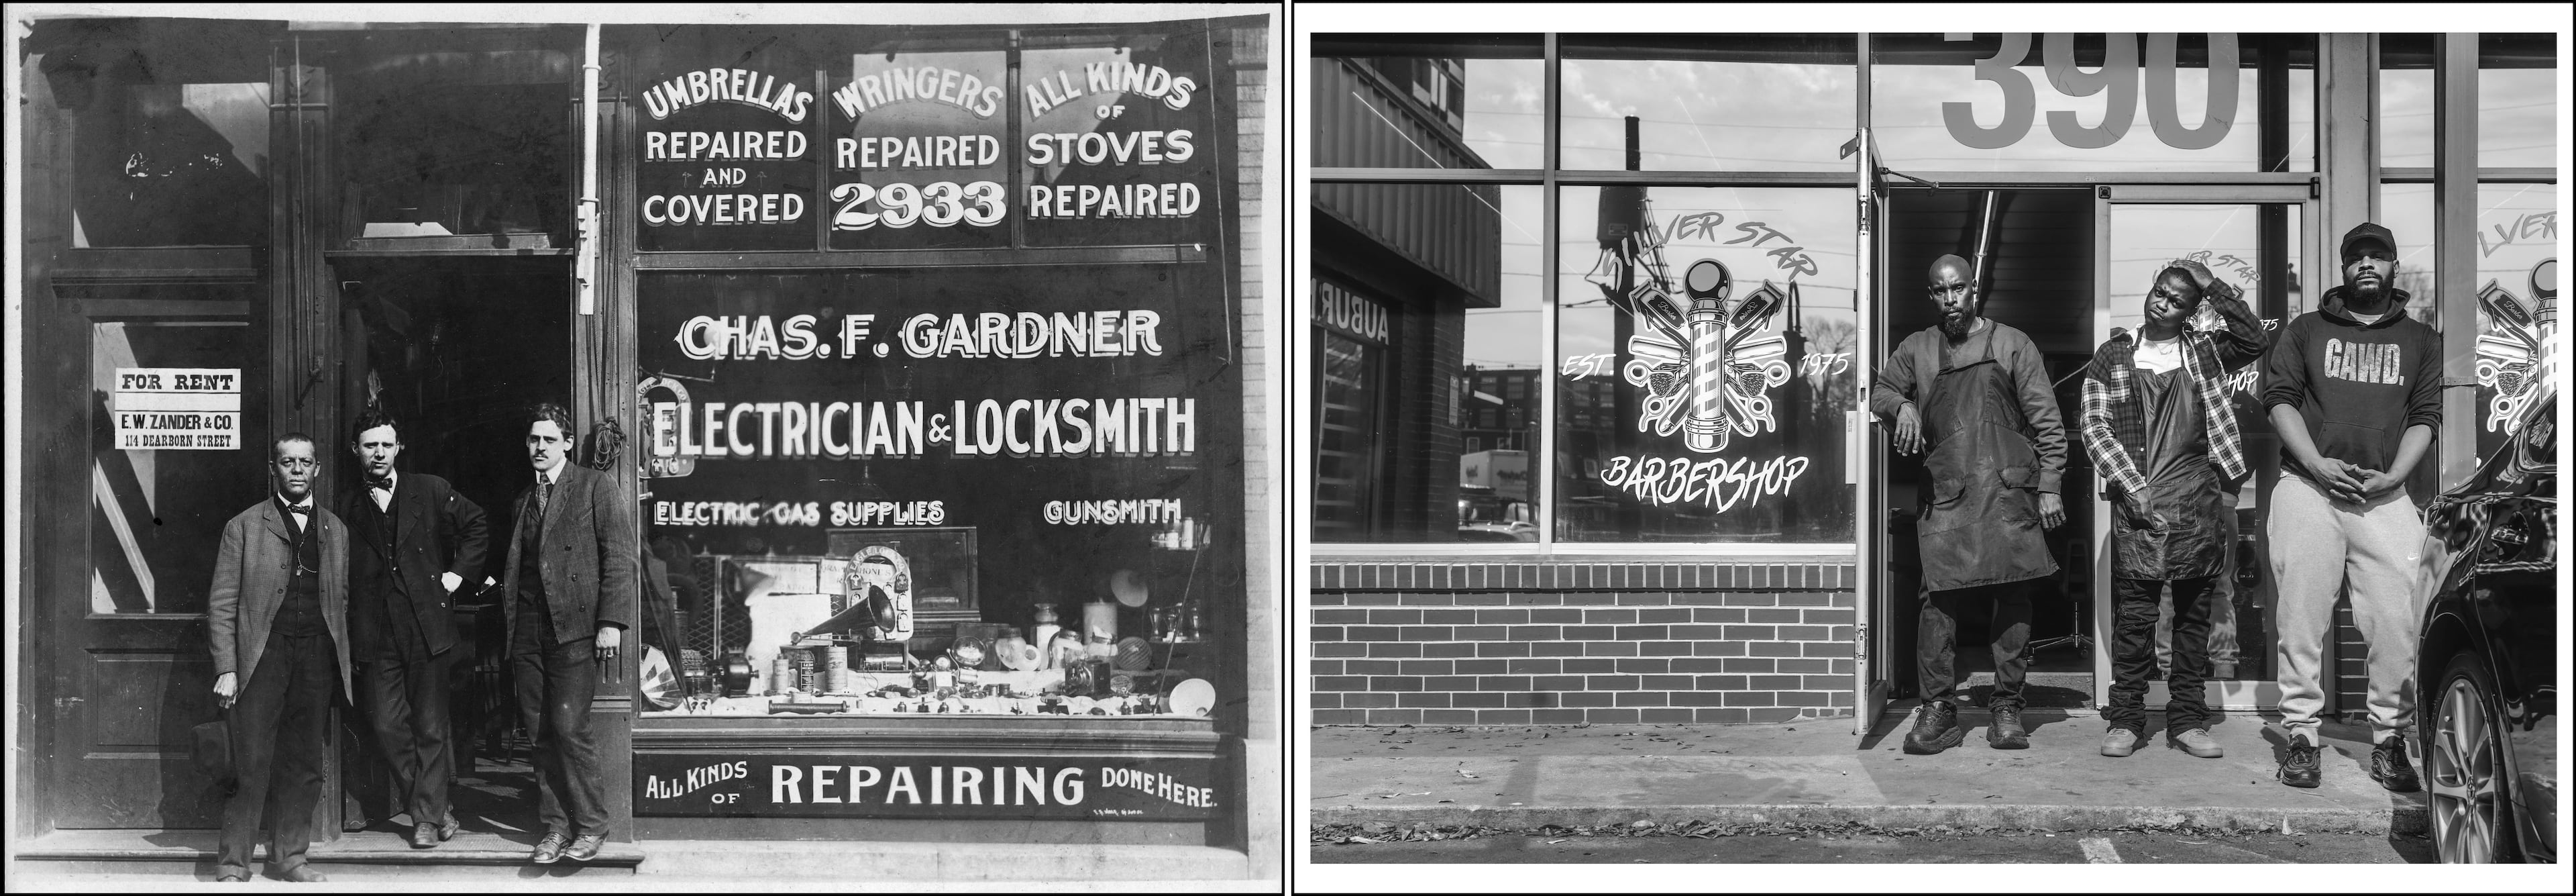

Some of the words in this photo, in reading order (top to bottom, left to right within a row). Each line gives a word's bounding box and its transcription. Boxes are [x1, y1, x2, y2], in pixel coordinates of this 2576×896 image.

[642, 68, 814, 123] UMBRELLAS
[833, 66, 1004, 120] WRINGERS
[1026, 70, 1082, 119] ALL
[1085, 62, 1197, 110] KINDS
[1941, 32, 2240, 150] 390
[1095, 105, 1126, 119] OF
[645, 131, 808, 160] REPAIRED
[836, 135, 1000, 170] REPAIRED
[1026, 130, 1194, 168] STOVES
[702, 168, 747, 187] AND
[643, 193, 804, 225] COVERED
[830, 181, 1006, 230] 2933
[1028, 182, 1201, 219] REPAIRED
[1603, 211, 1724, 293] SILVER
[1723, 221, 1818, 282] STAR
[2212, 254, 2261, 285] STAR
[1657, 301, 1677, 321] Barber
[2259, 318, 2279, 331] 75
[2504, 300, 2523, 320] Barber
[674, 314, 831, 360] CHAS.
[837, 313, 890, 359] F.
[898, 309, 1163, 359] GARDNER
[1562, 352, 1617, 382] EST.
[1799, 352, 1852, 376] 1975
[2324, 338, 2405, 386] GAWD.
[122, 374, 162, 390] FOR
[174, 374, 233, 391] RENT
[150, 414, 201, 430] ZANDER
[204, 416, 212, 429] &
[214, 415, 233, 430] CO.
[652, 401, 924, 459] ELECTRICIAN
[928, 412, 952, 446] &
[953, 397, 1195, 457] LOCKSMITH
[125, 435, 139, 447] 114
[143, 435, 193, 447] DEARBORN
[197, 435, 231, 448] STREET
[1600, 454, 1810, 515] BARBERSHOP
[654, 501, 759, 526] ELECTRIC
[773, 500, 820, 526] GAS
[830, 499, 945, 526] SUPPLIES
[1043, 497, 1182, 526] GUNSMITH
[849, 548, 872, 570] EAGLE
[645, 774, 683, 799] ALL
[687, 760, 747, 794] KINDS
[771, 764, 1085, 806] REPAIRING
[1102, 766, 1155, 795] DONE
[1158, 771, 1218, 809] HERE.
[711, 793, 740, 804] OF
